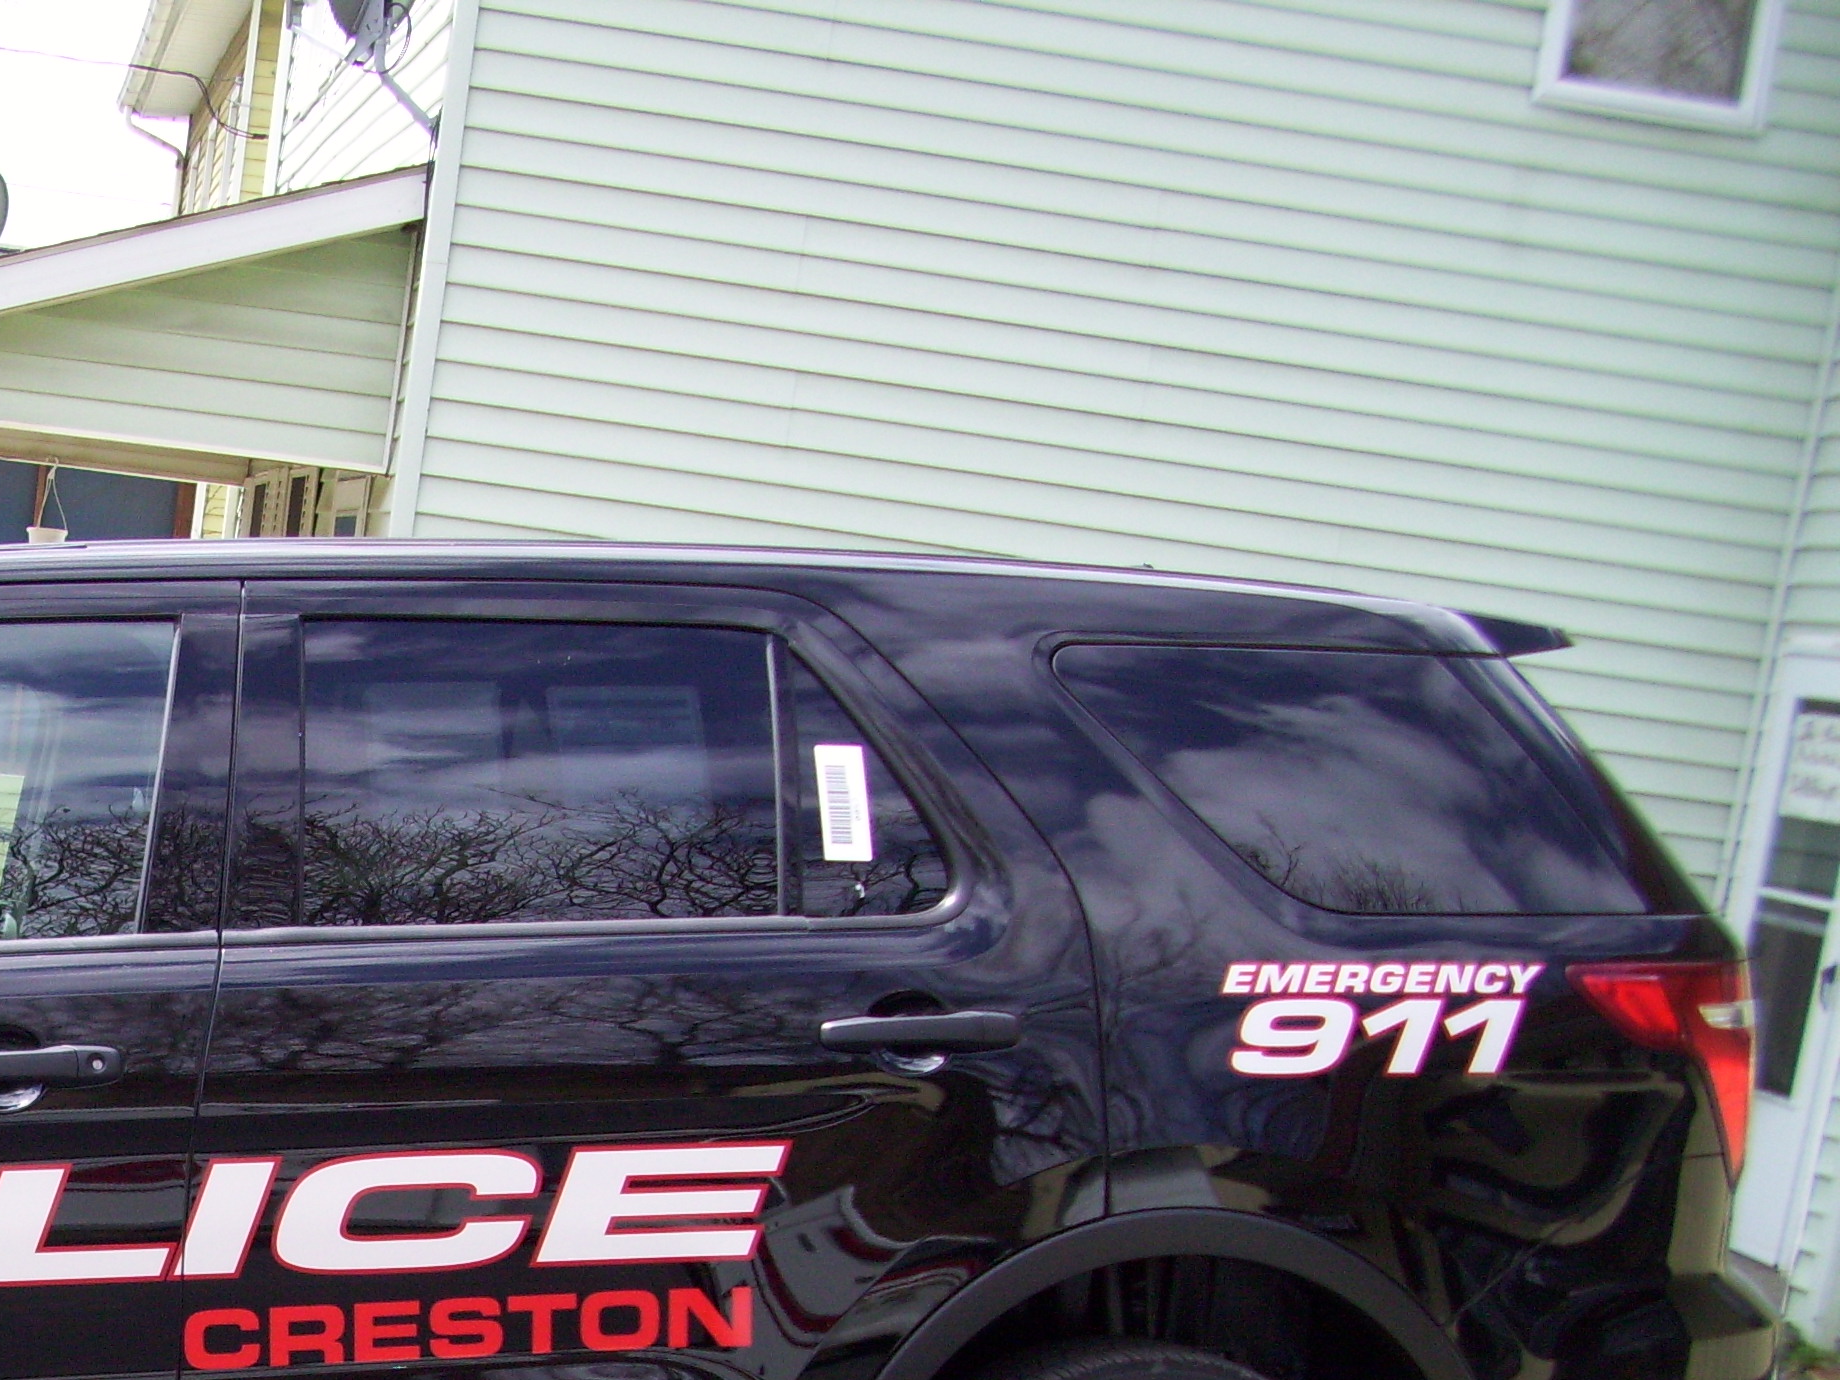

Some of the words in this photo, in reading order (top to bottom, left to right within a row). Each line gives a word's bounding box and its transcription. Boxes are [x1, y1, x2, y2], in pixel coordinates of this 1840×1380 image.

[1221, 961, 1546, 996] EMERGENCY
[1229, 996, 1527, 1077] 911
[183, 1286, 754, 1371] CRESTON
